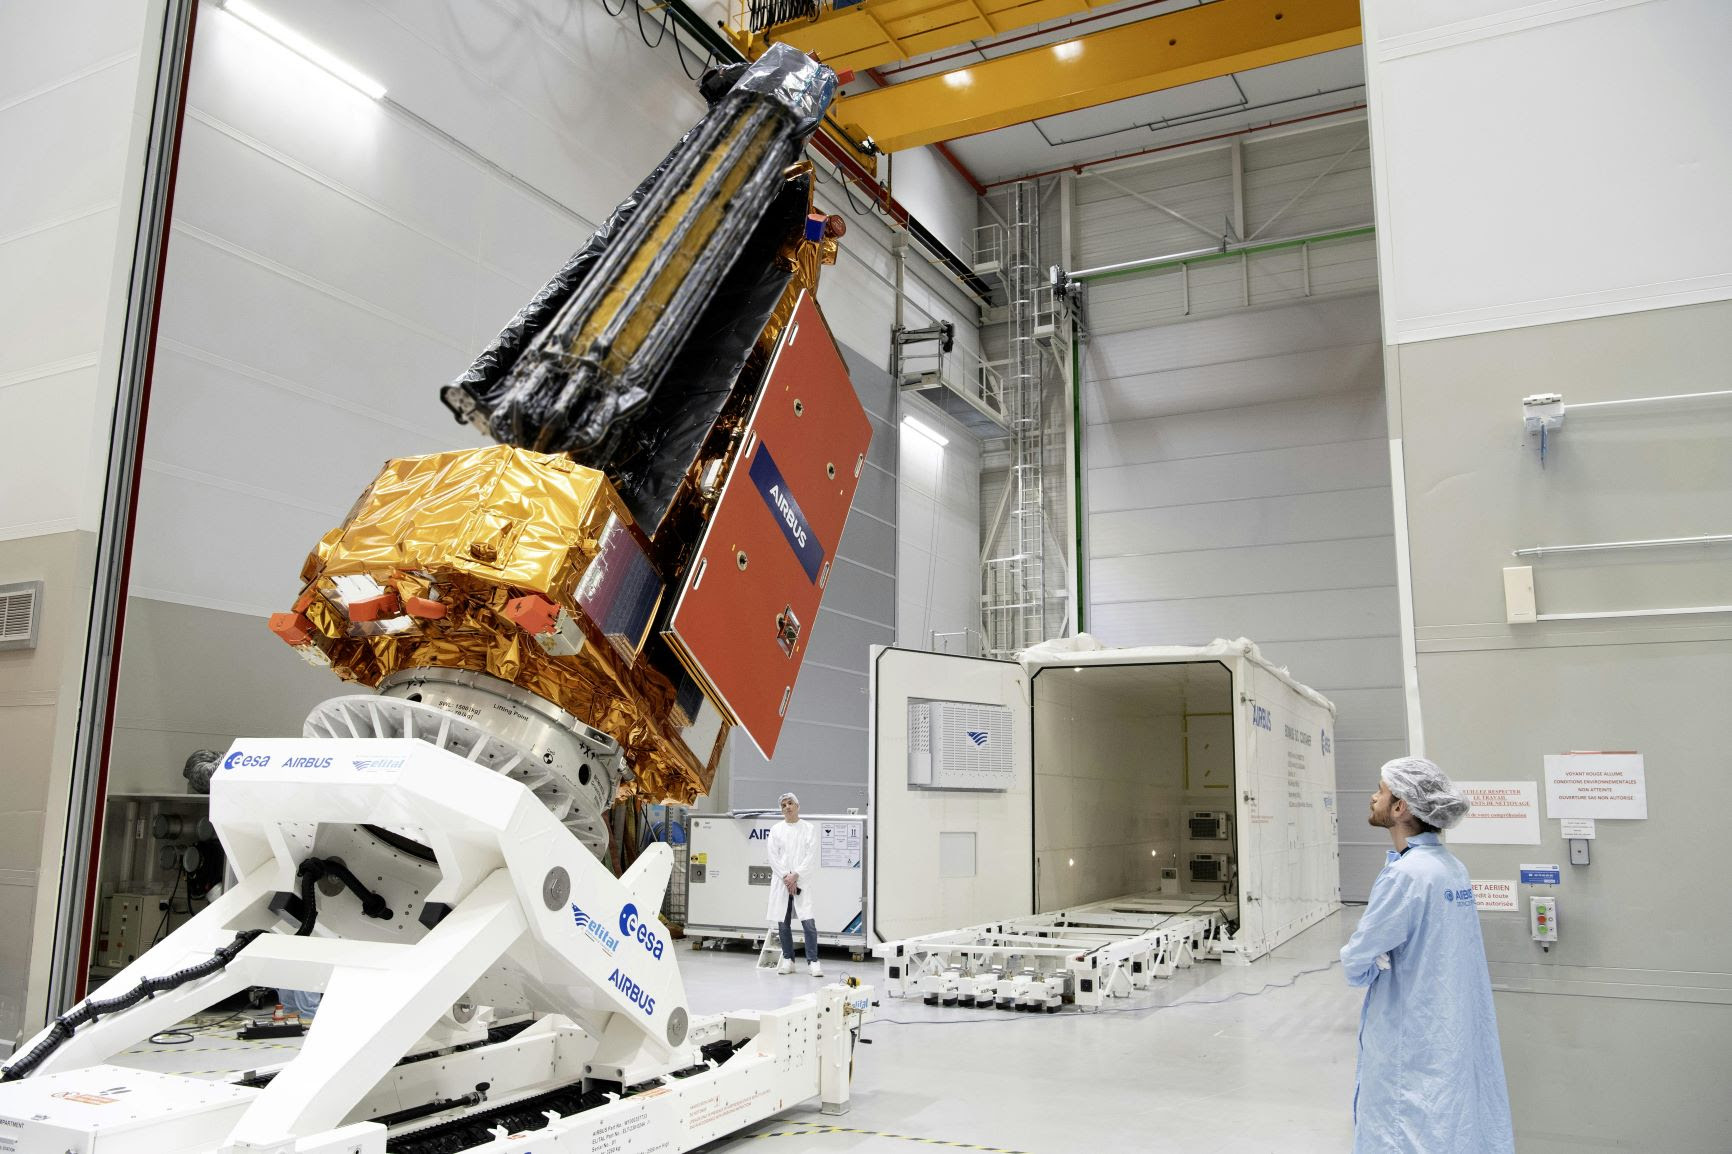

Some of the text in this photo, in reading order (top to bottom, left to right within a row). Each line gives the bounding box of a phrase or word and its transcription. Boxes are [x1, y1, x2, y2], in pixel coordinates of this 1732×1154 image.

[769, 484, 807, 548] AIRBUS
[493, 703, 513, 716] Lifting
[1253, 705, 1272, 732] AIRBUS
[281, 757, 334, 769] AIRBUS
[749, 828, 771, 840] AIR
[588, 919, 620, 952] elital
[637, 923, 664, 960] esa
[608, 968, 655, 1015] AIRBUS
[592, 1126, 608, 1137] AIRBUS
